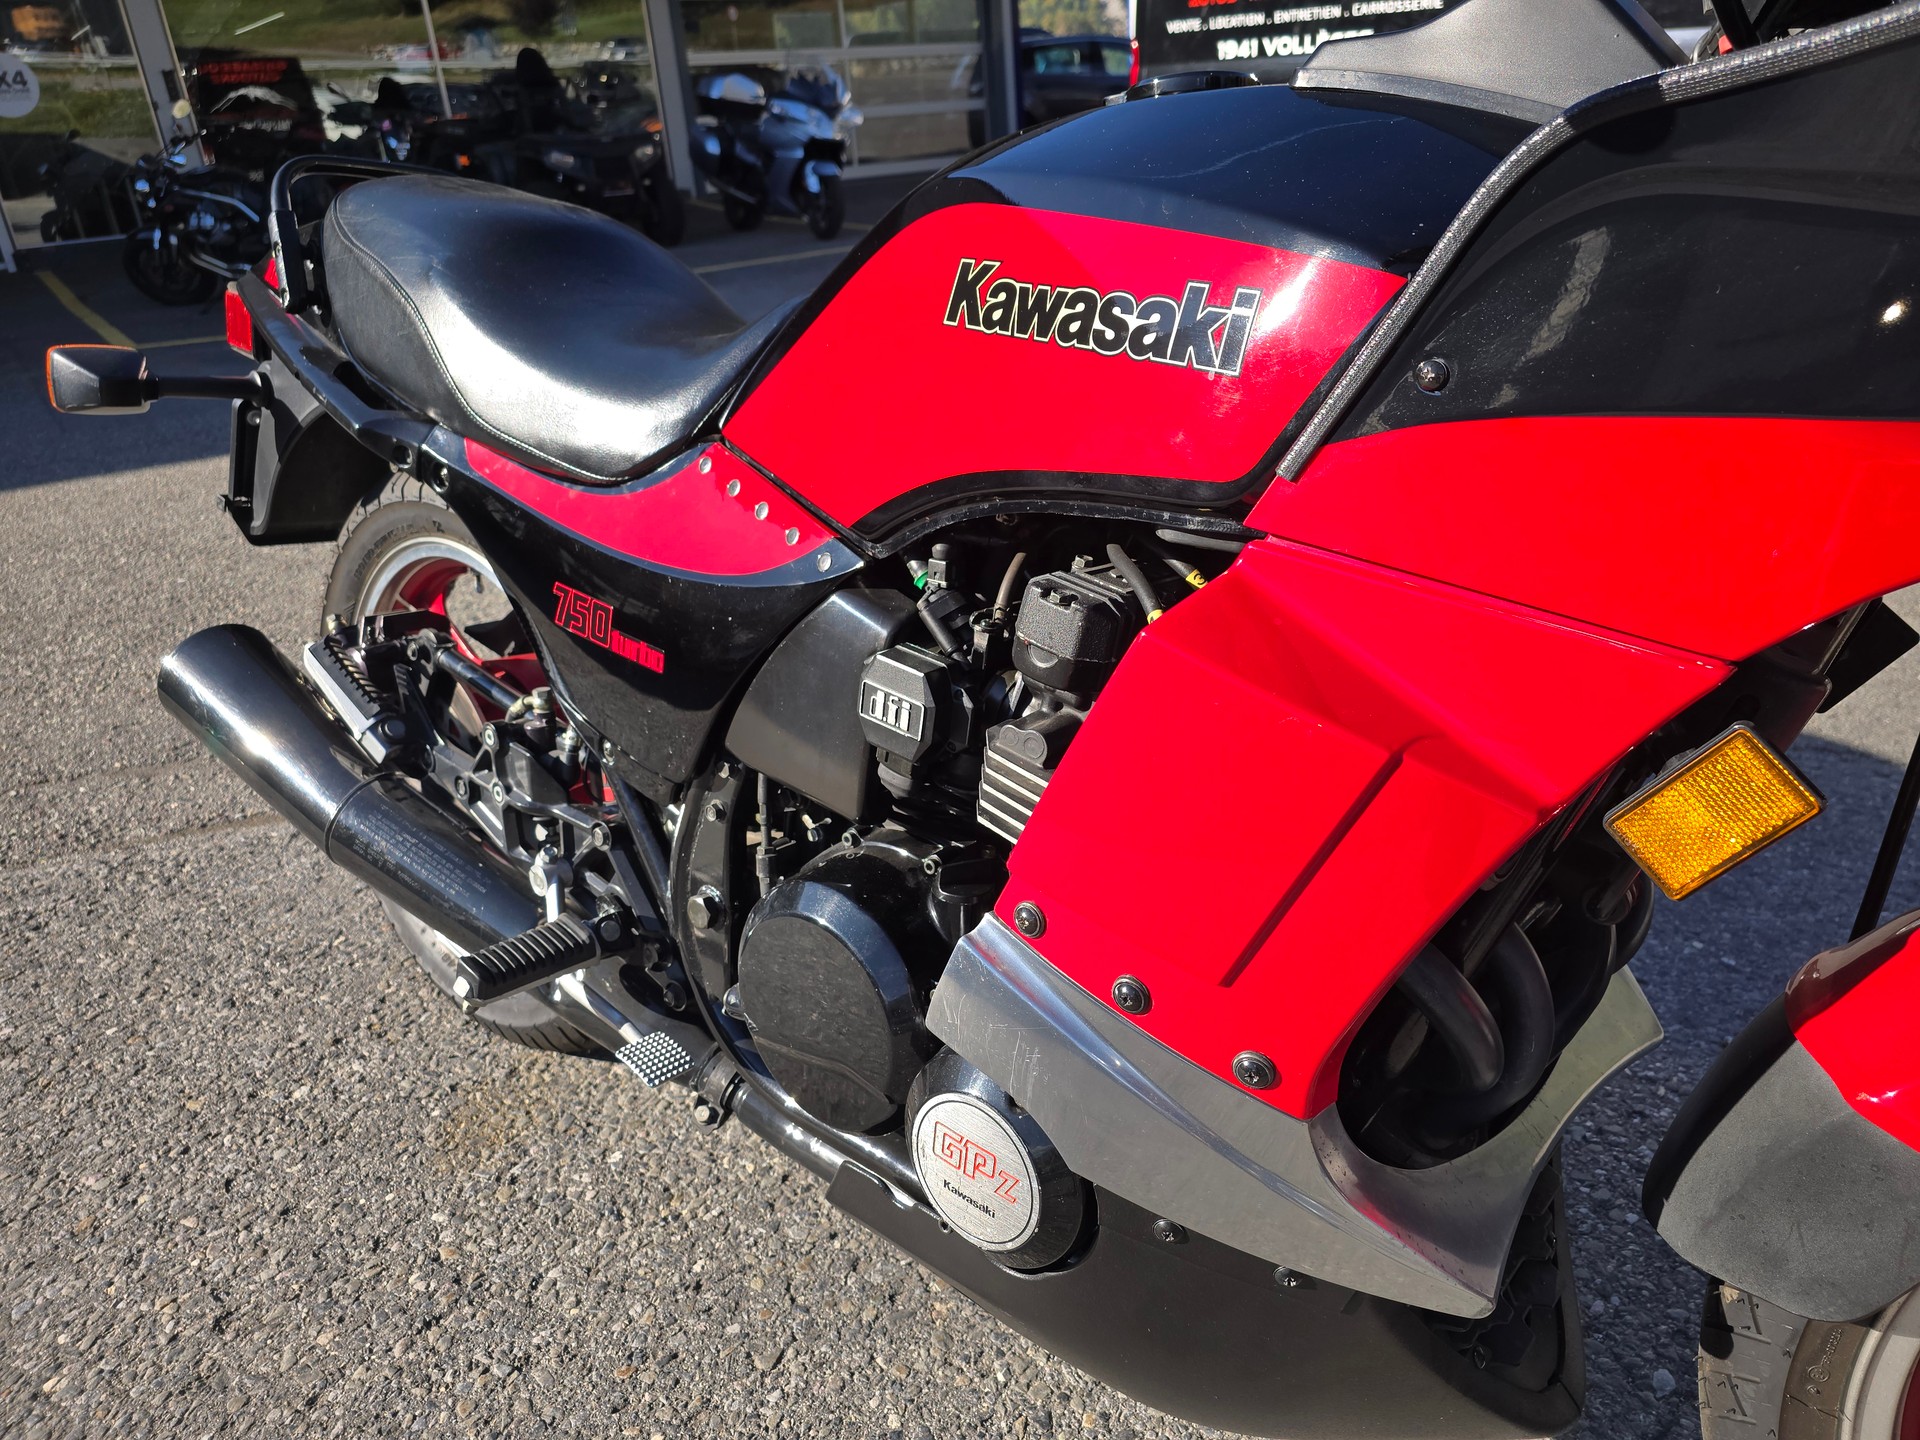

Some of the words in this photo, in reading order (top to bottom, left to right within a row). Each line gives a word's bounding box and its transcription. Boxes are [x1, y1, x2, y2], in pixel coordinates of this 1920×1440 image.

[1166, 18, 1202, 34] VENTE
[1208, 12, 1265, 30] LOCATION
[1273, 4, 1342, 24] ENTRETIEN
[1217, 37, 1258, 60] 1941
[942, 257, 1263, 378] Kawasaki
[553, 581, 613, 648] 750
[943, 1179, 996, 1219] Kawasaki
